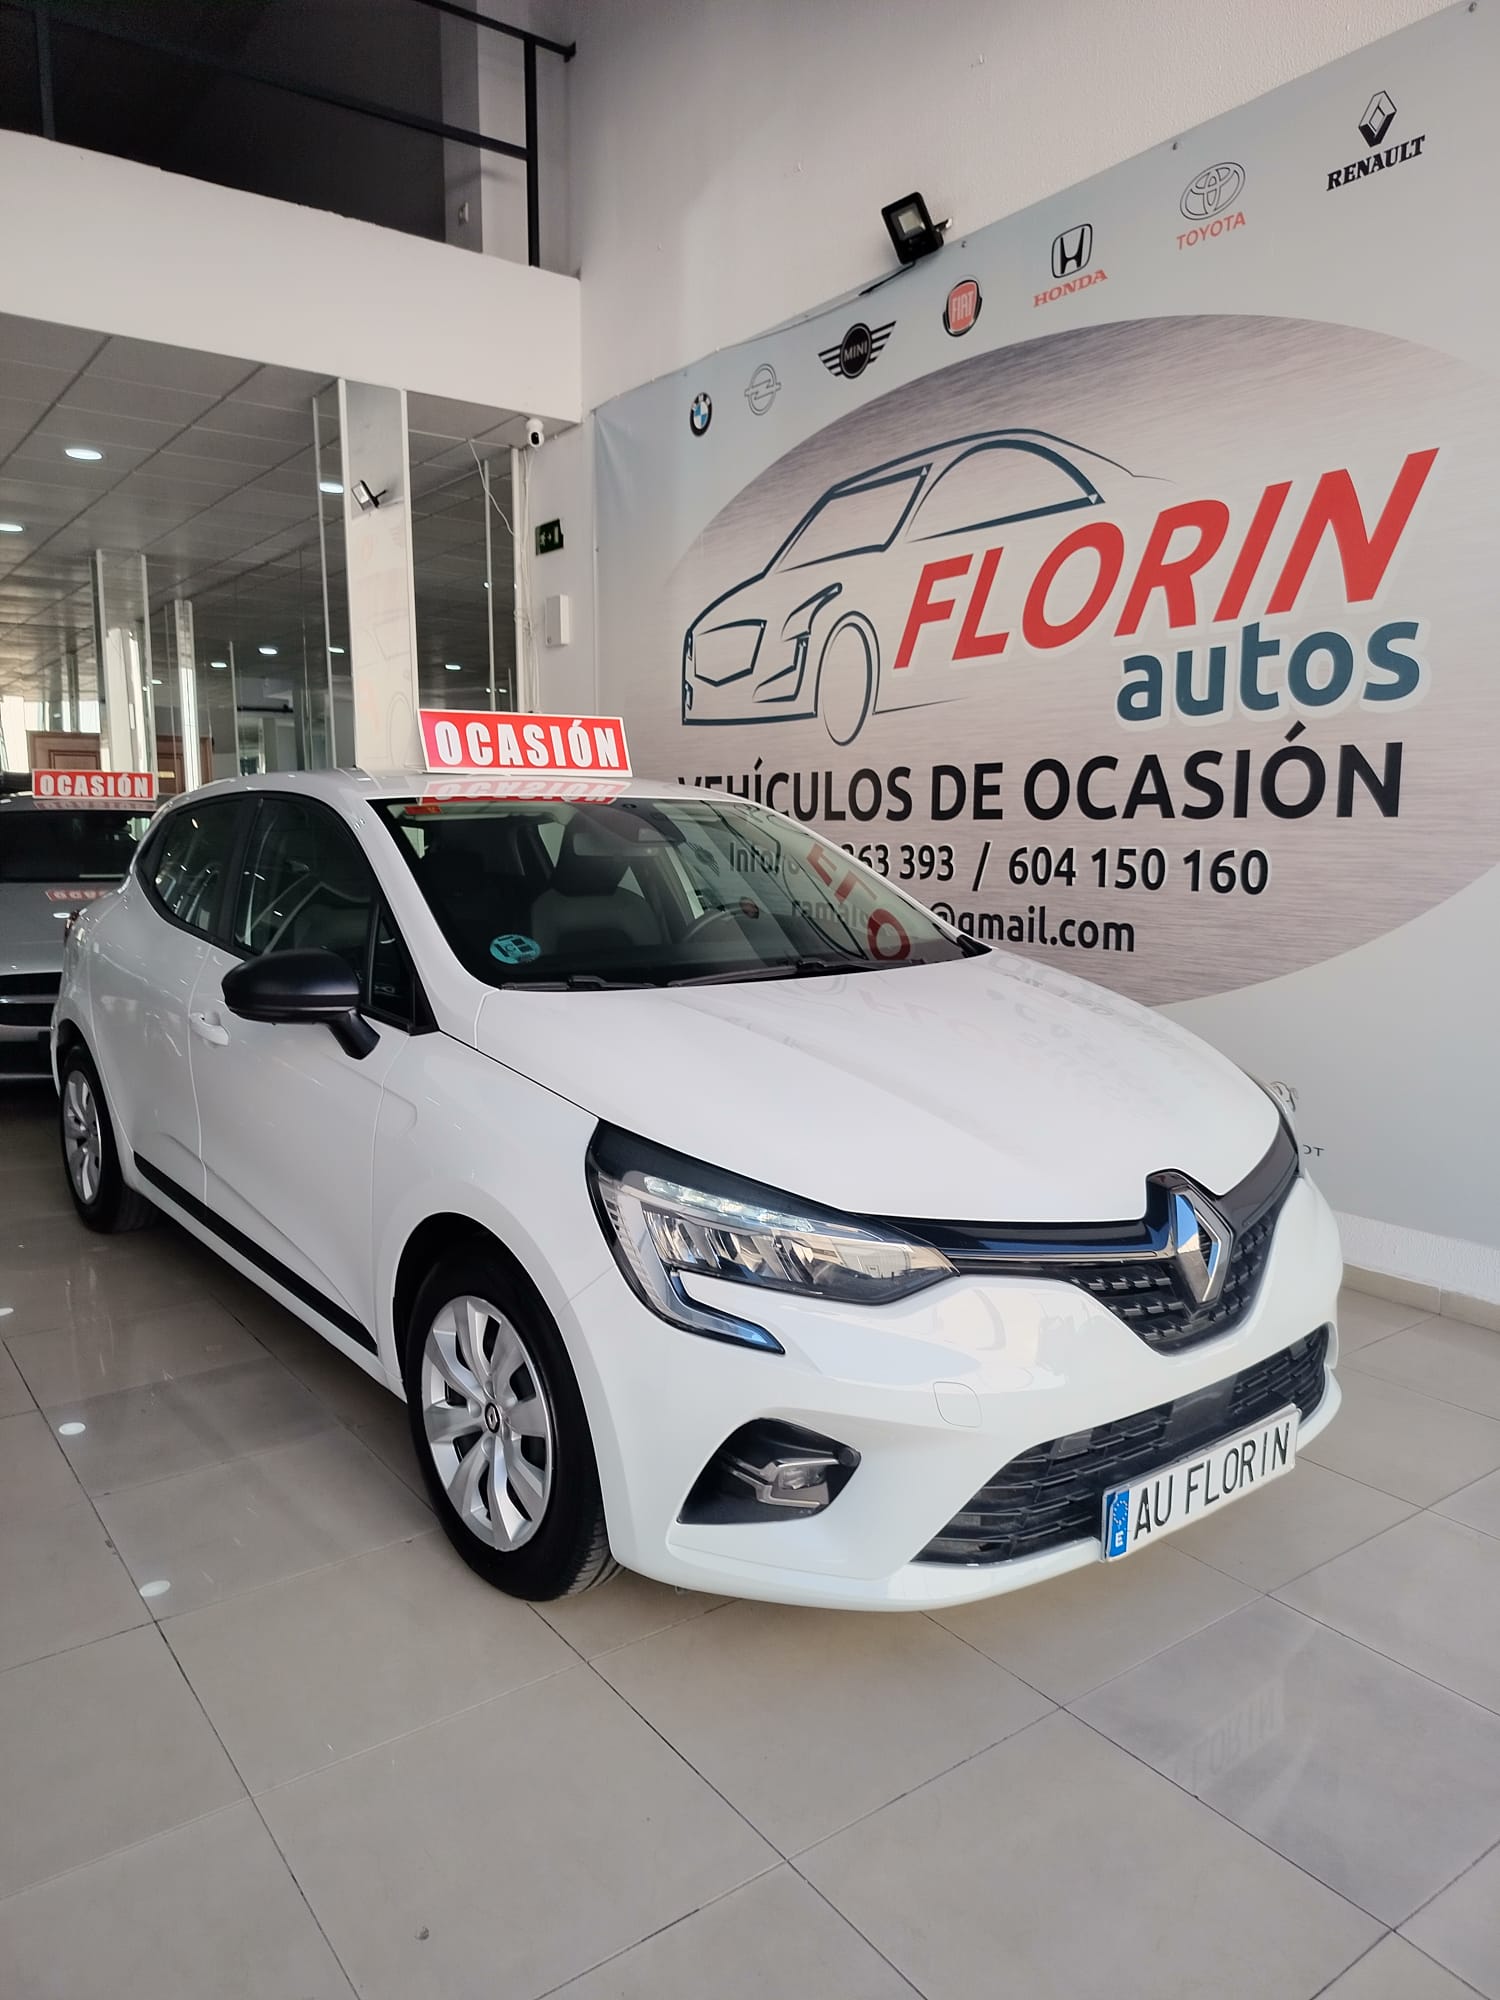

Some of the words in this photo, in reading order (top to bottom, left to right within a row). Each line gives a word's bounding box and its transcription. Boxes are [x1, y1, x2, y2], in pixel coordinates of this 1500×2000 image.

[1326, 134, 1426, 191] RENAULT
[1176, 211, 1246, 250] TOYOTA
[951, 290, 974, 324] FIAT
[1033, 269, 1108, 308] HONDA
[843, 340, 869, 362] MINI
[894, 447, 1440, 669] FLORIN
[1116, 621, 1420, 722] autos
[434, 719, 620, 768] OCASIÓN
[40, 773, 149, 798] OCASIÓN
[931, 762, 1004, 820] DE
[1023, 720, 1404, 820] OCASIÓN
[899, 844, 954, 881] 393
[972, 841, 991, 892] /
[1008, 846, 1076, 887] 604
[1091, 847, 1166, 891] 150
[1183, 849, 1269, 896] 160
[1114, 1530, 1124, 1548] E
[1134, 1475, 1173, 1540] AU
[1185, 1422, 1290, 1514] FLORIN
